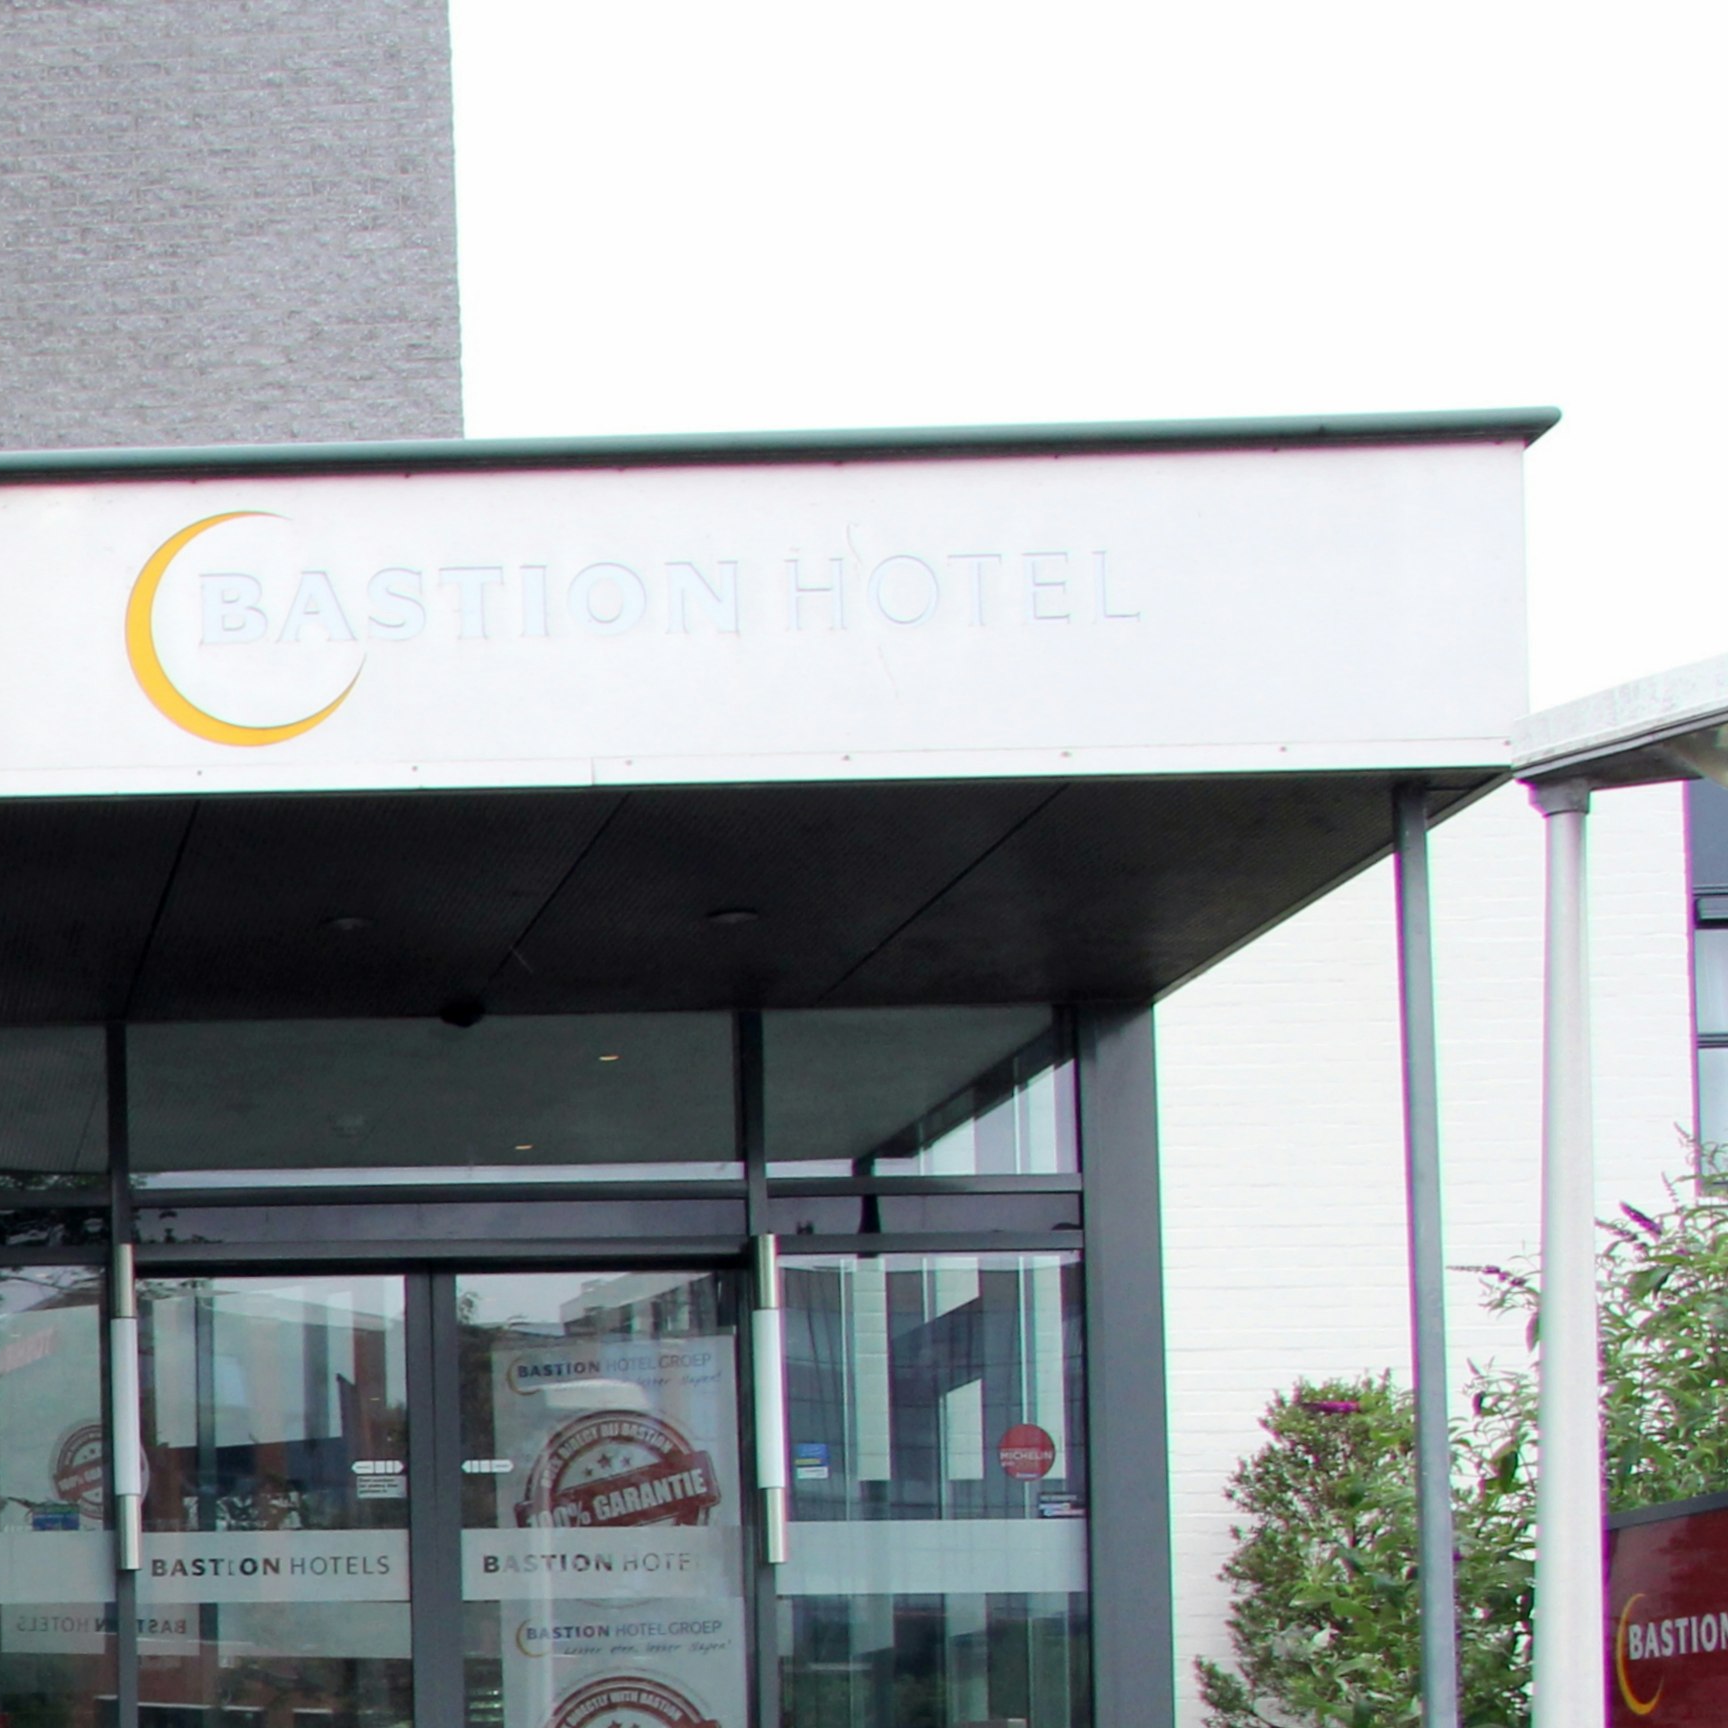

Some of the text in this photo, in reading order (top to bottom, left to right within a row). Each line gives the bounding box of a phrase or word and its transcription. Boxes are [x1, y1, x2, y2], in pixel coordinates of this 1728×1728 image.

[197, 549, 1143, 647] BASTION HOTEL
[517, 1361, 600, 1379] BASTION
[593, 1468, 708, 1521] GARANTIE
[151, 1555, 391, 1577] BASTION HOTELS
[483, 1553, 613, 1573] BASTION
[527, 1625, 610, 1640] BASTION
